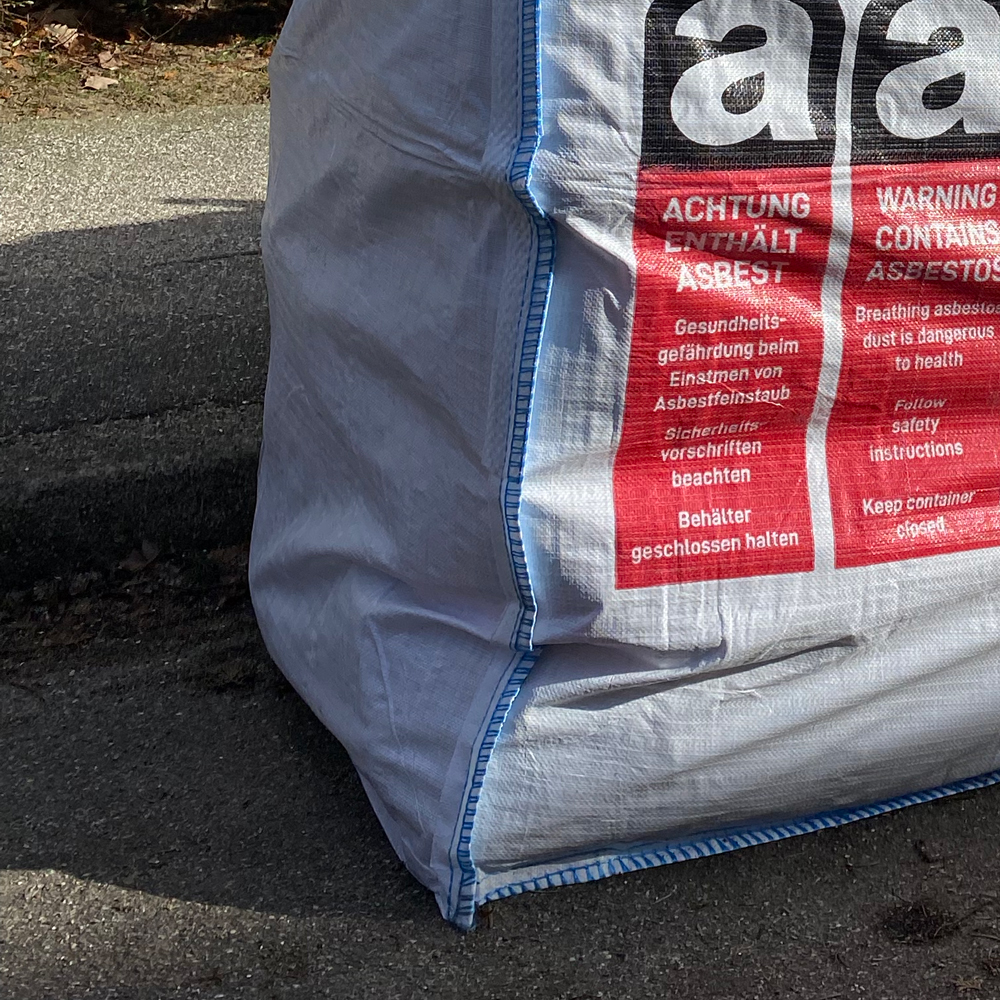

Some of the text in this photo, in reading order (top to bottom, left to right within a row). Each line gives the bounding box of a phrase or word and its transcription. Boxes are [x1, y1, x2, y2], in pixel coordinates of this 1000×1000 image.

[662, 192, 811, 222] ACHTUNG
[876, 183, 997, 213] WARNING
[664, 224, 802, 253] ENTHÄLT
[676, 261, 784, 293] ASBEST
[855, 303, 930, 323] Breathing
[675, 315, 787, 336] Gesundheits-
[862, 325, 995, 350] dust is dangerous
[658, 338, 799, 365] gefährdung beim
[895, 351, 963, 372] to health
[669, 366, 783, 387] Einatmen von
[653, 387, 791, 412] Asbestfeinstaub
[893, 398, 947, 413] Follow
[664, 420, 768, 441] Sicherheits-
[891, 416, 940, 435] safety
[661, 440, 763, 462] vorschriften
[869, 440, 963, 462] instructions
[671, 467, 751, 488] beachten
[863, 490, 975, 517] Keep container
[678, 507, 752, 529] Behälter
[896, 518, 946, 539] closed
[631, 530, 799, 564] geschlossen halten
